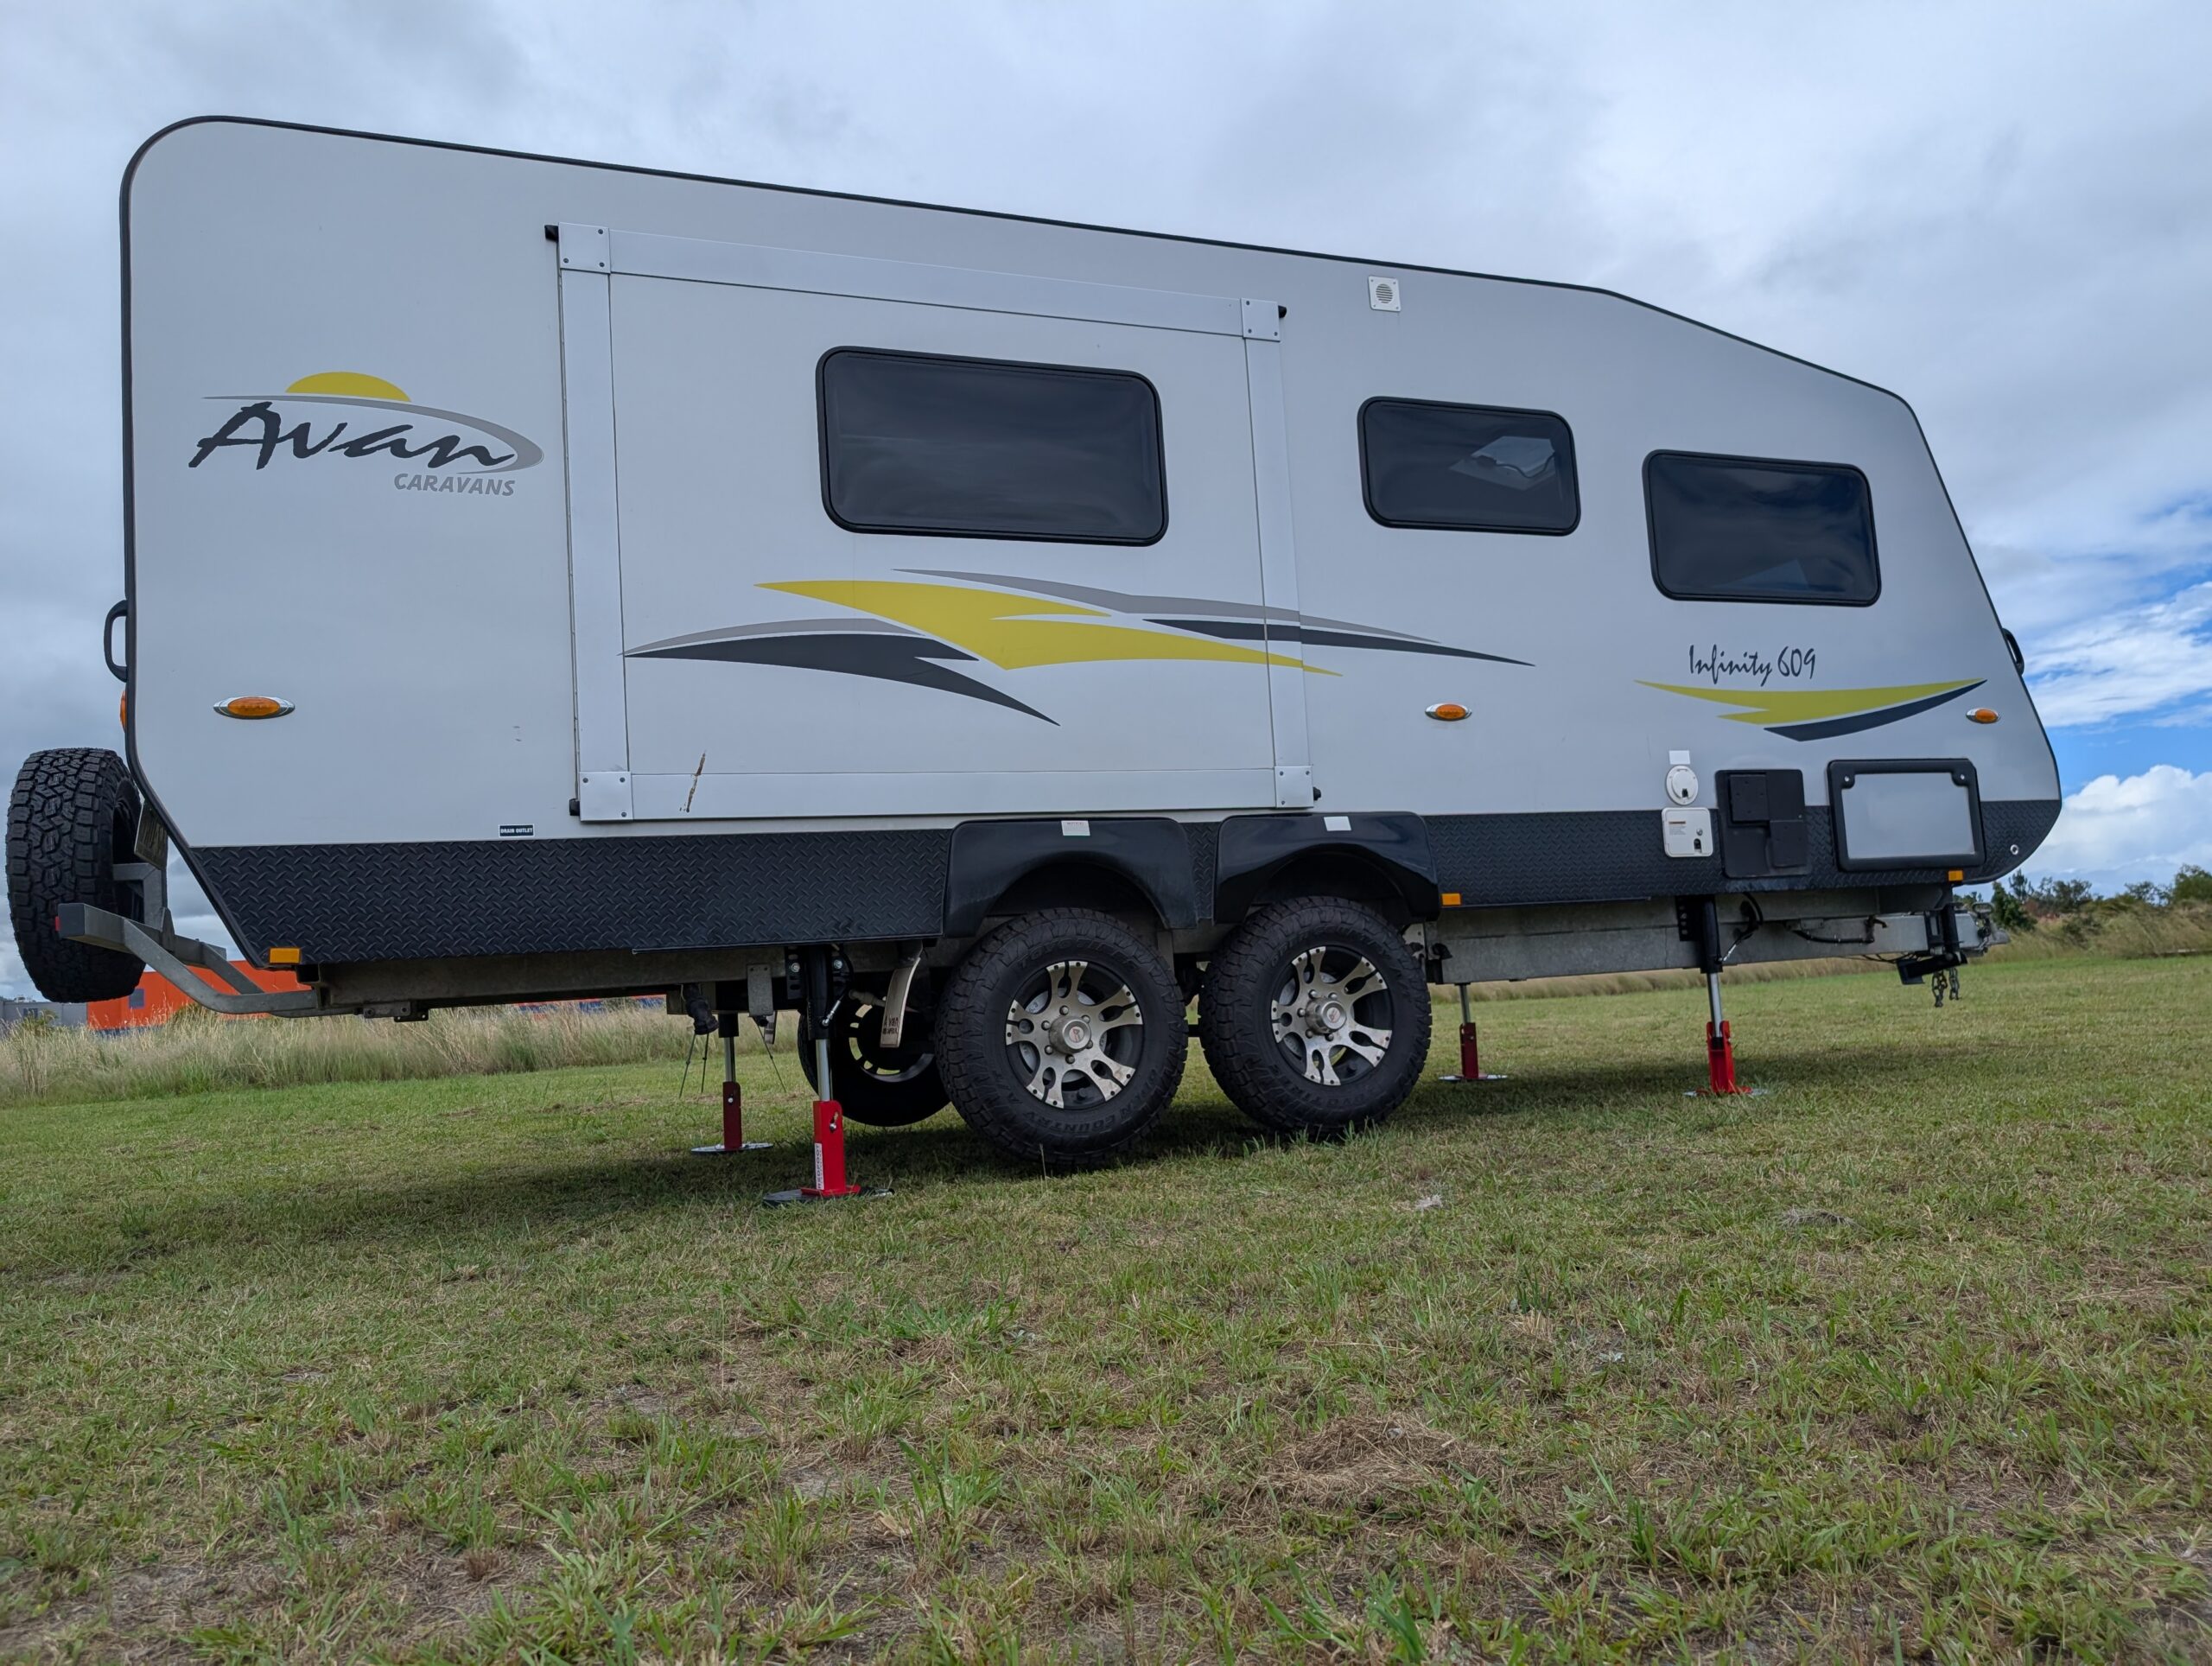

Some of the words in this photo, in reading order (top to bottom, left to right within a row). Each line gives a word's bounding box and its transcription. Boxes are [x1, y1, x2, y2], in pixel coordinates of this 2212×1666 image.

[188, 402, 515, 470] Avan
[394, 473, 516, 496] CARAVANS
[1689, 644, 1772, 687] Infinity
[1777, 645, 1815, 679] 609
[1022, 1110, 1117, 1133] COUNTRY
